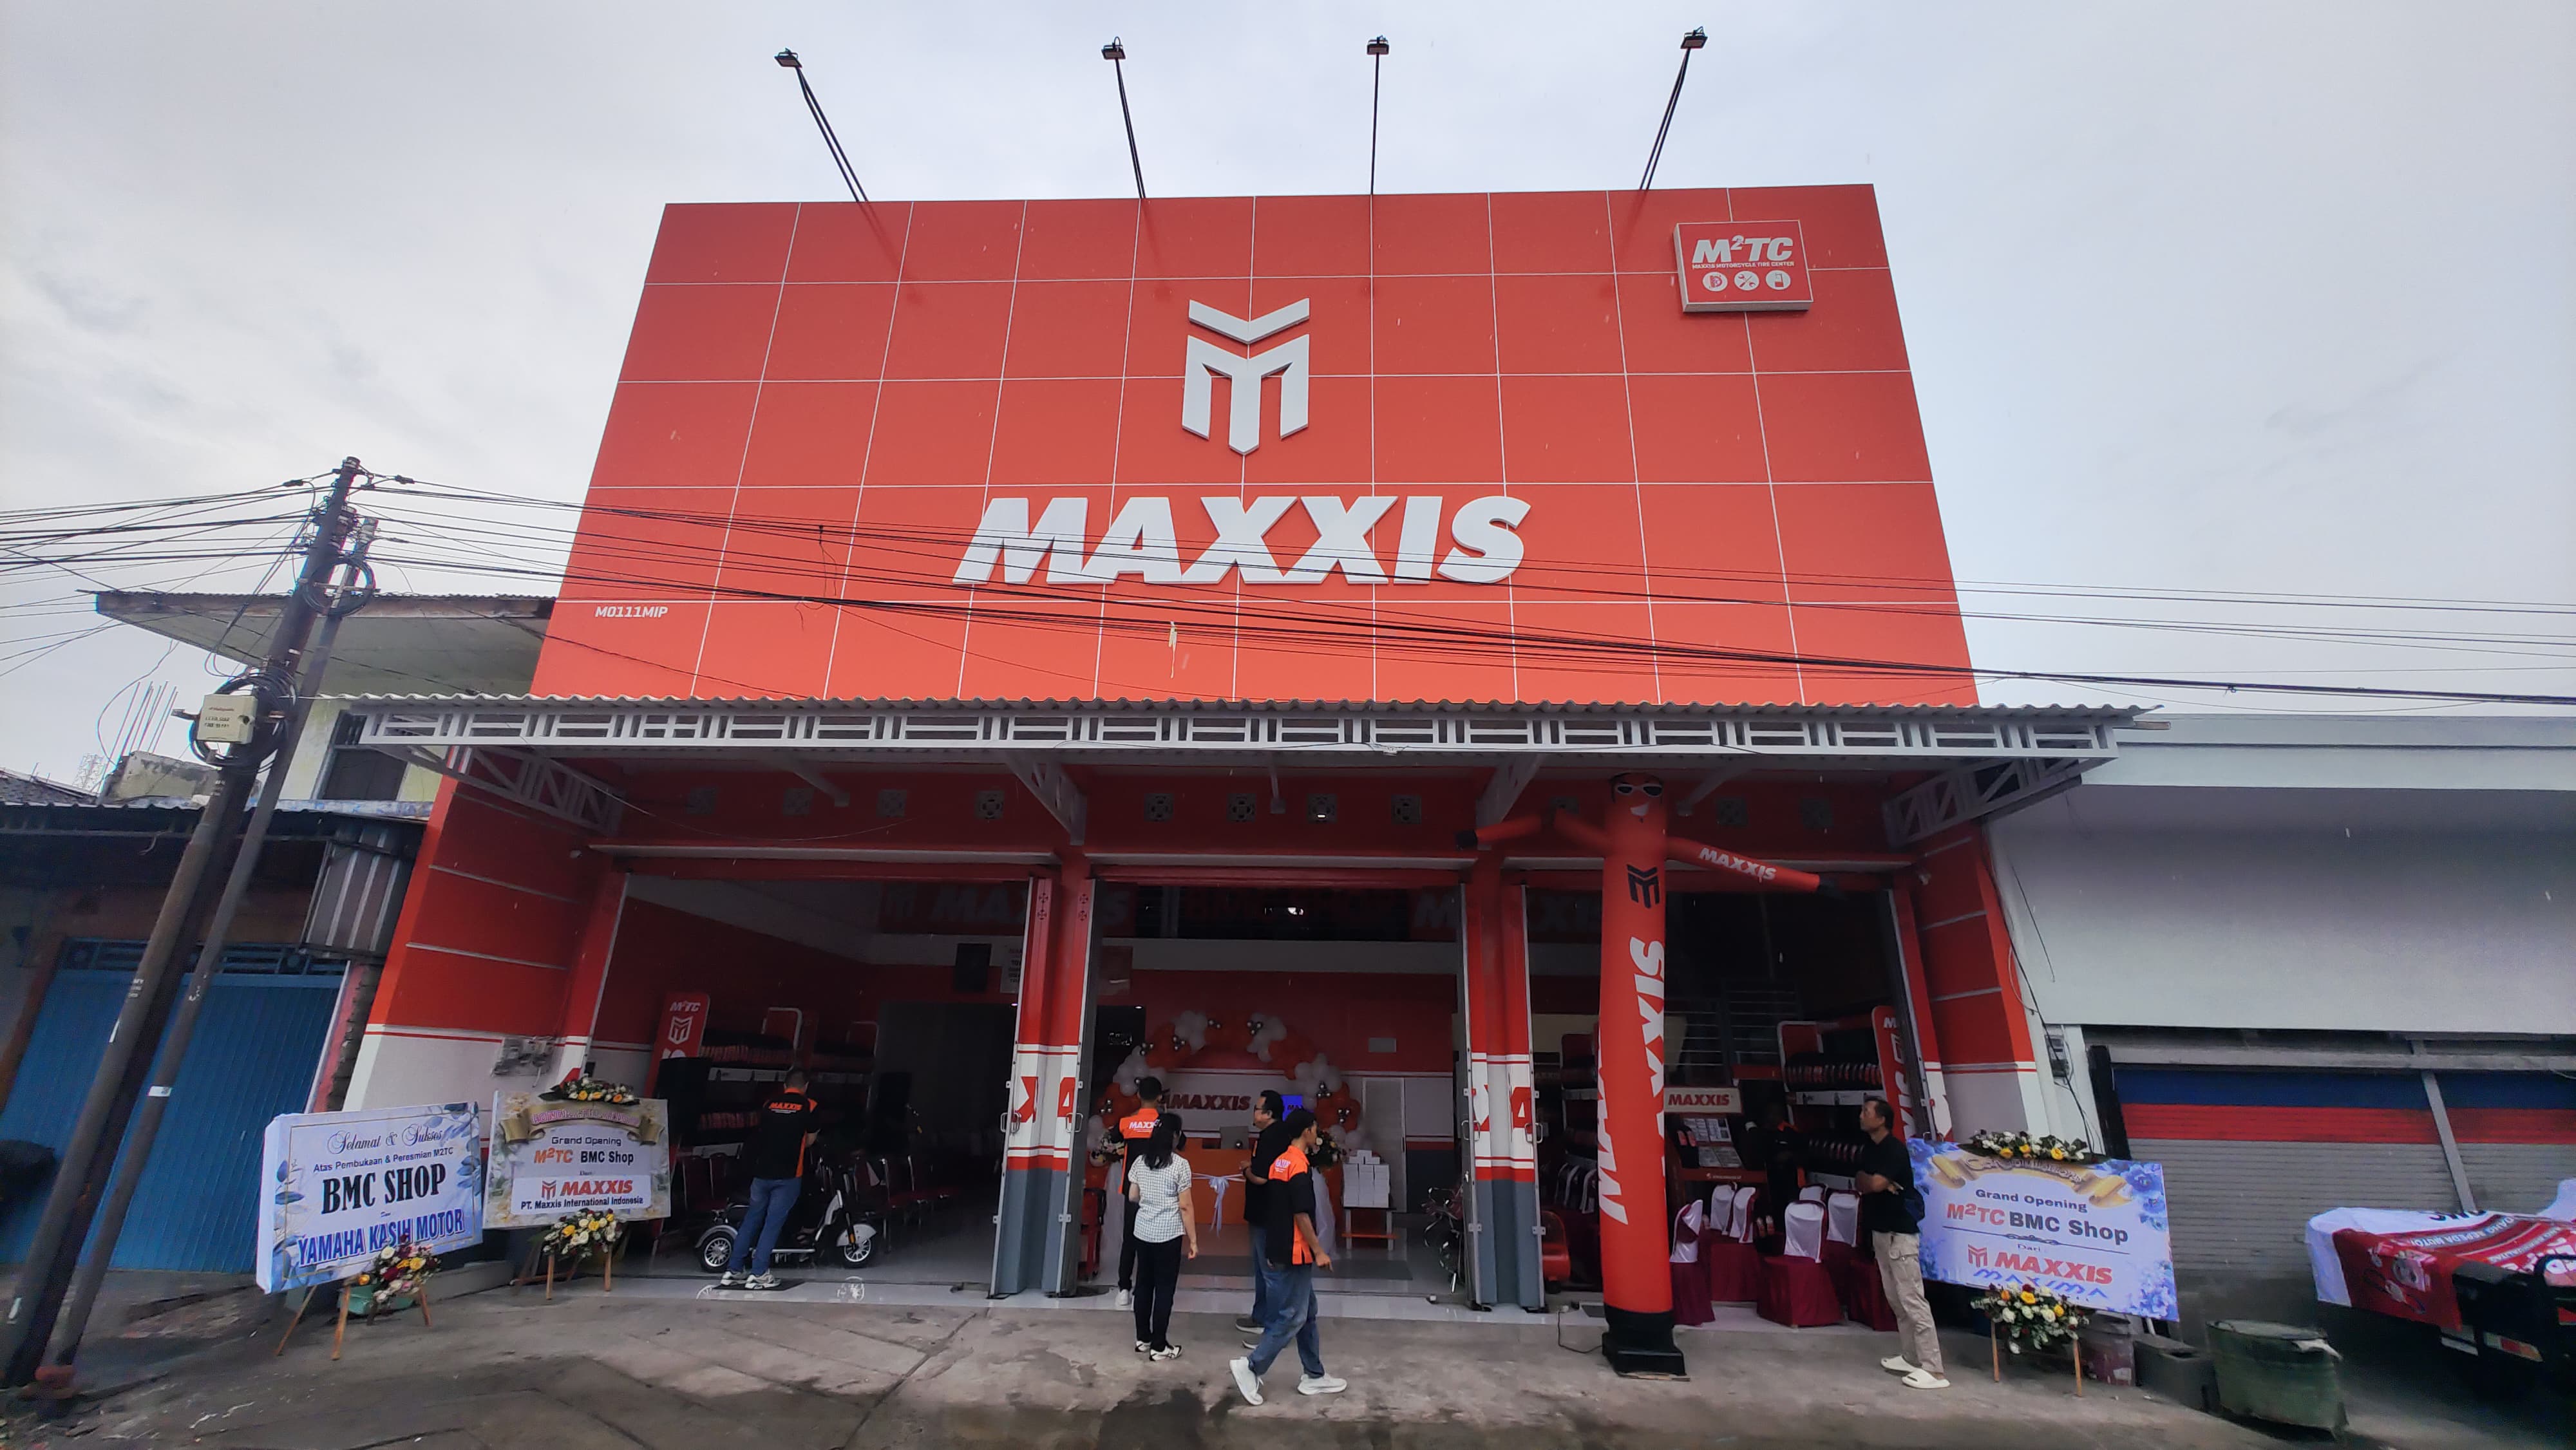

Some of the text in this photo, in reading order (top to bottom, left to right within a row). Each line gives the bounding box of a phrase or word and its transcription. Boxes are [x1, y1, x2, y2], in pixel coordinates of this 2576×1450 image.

[952, 495, 1532, 584] MAXXIS
[1699, 847, 1777, 880] MAXXIS
[1172, 1095, 1251, 1111] MAXXIS
[1669, 1094, 1730, 1106] MAXXIS
[327, 1130, 381, 1154] Selamat
[402, 1124, 442, 1147] Sukses
[551, 1136, 621, 1146] Grand Opening
[314, 1163, 333, 1172] Atas
[335, 1158, 383, 1170] Pembukaan
[393, 1151, 431, 1163] Peresmian
[433, 1147, 453, 1156] M2TC
[580, 1151, 606, 1163] BMC
[609, 1150, 634, 1166] Shop
[321, 1163, 446, 1214] BMC SHOP
[560, 1180, 632, 1196] MAXXIS
[520, 1196, 643, 1210] PT. Maxxis International Indonesia
[1975, 1189, 2088, 1214] Grand Opening
[298, 1209, 464, 1268] YAMAHA KASIH MOTOR
[2009, 1211, 2060, 1232] BMC
[2069, 1219, 2129, 1246] Shop
[1994, 1252, 2113, 1285] MAXXIS
